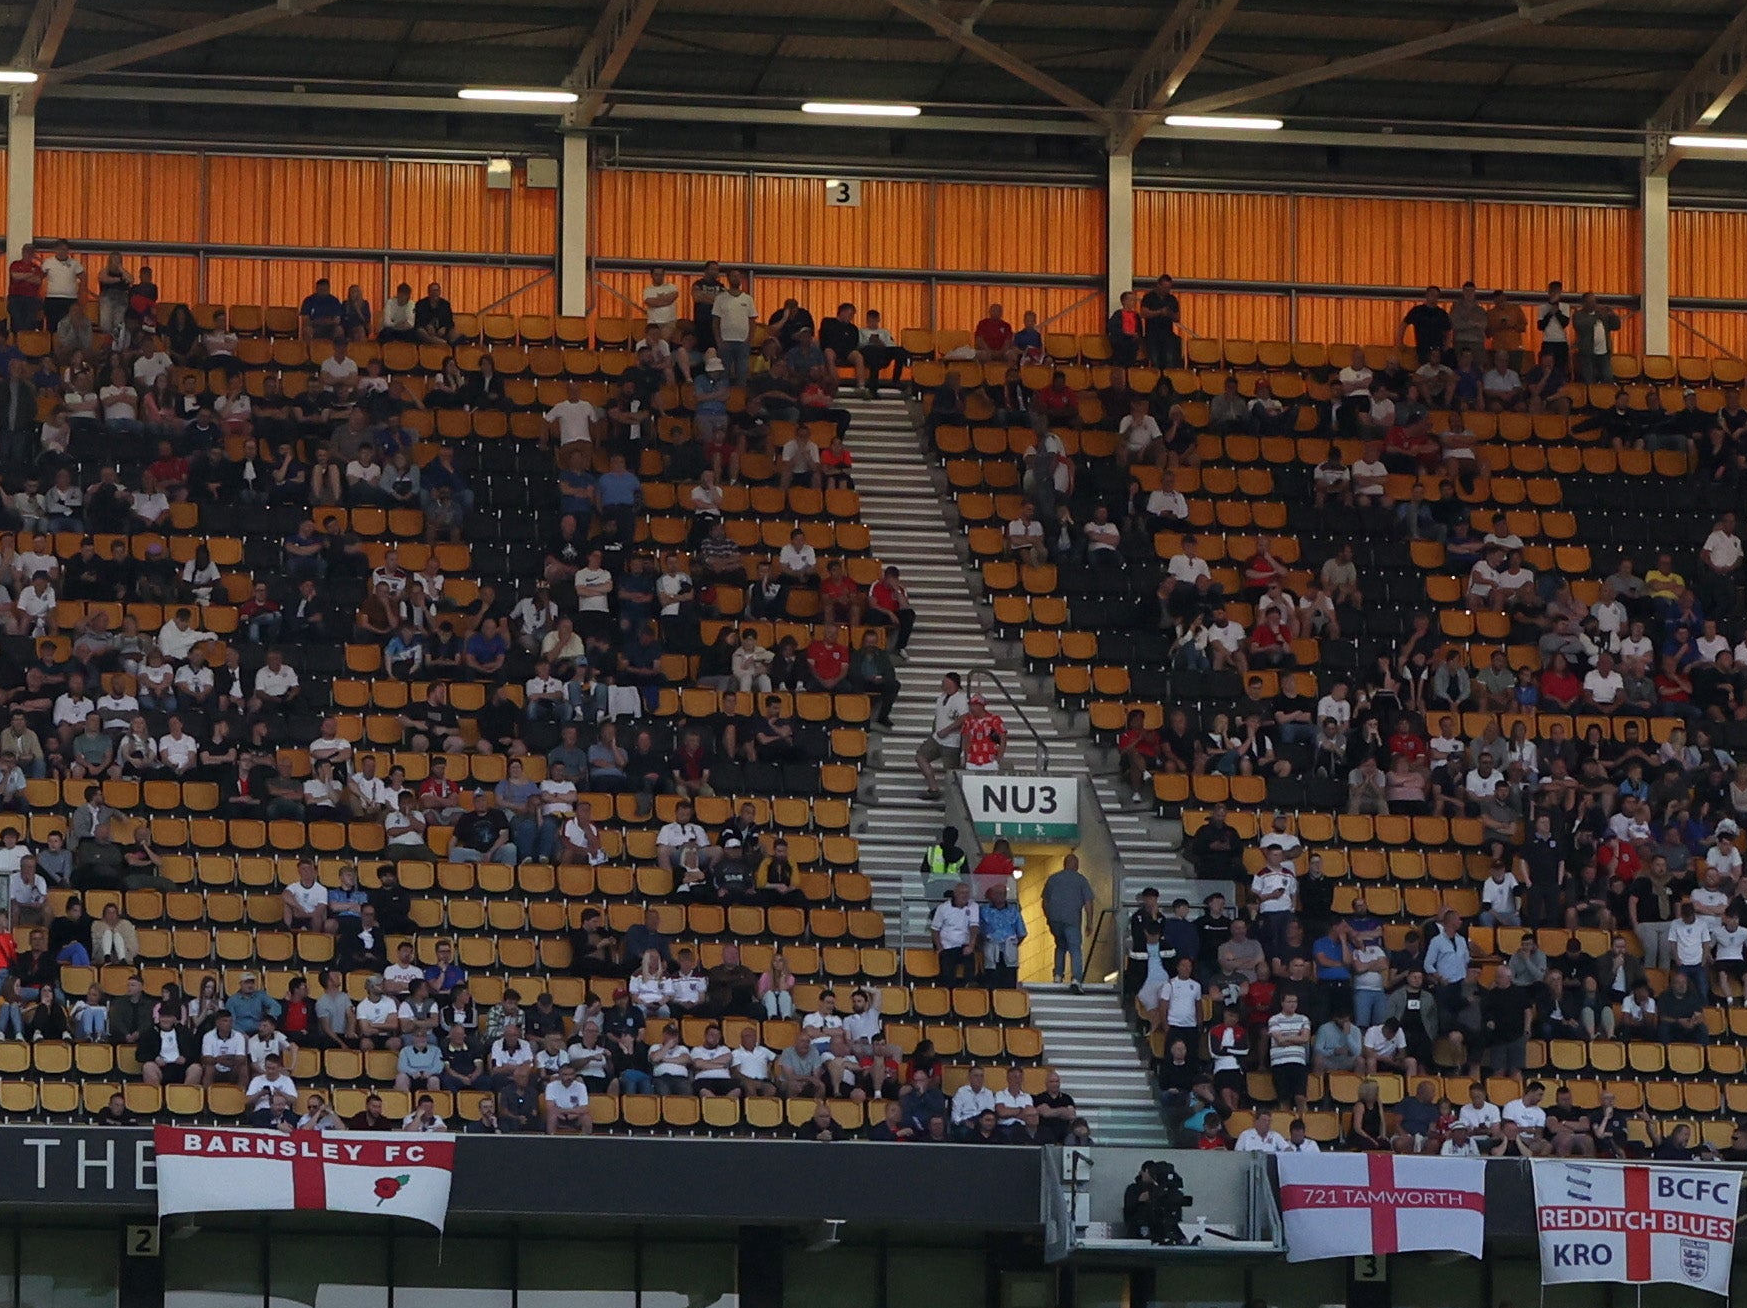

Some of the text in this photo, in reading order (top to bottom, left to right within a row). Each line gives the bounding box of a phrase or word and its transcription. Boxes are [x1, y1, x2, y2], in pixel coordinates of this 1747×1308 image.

[836, 182, 851, 203] 3
[982, 784, 1058, 814] NU3
[184, 1133, 426, 1165] BARNSLEY FC
[23, 1138, 158, 1191] THE
[1303, 1189, 1464, 1207] 721 TAMWORTH
[1657, 1176, 1731, 1206] BCFC
[1542, 1209, 1732, 1240] REDDITCH BLUES
[135, 1229, 152, 1253] 2
[1362, 1254, 1378, 1279] 3
[1553, 1243, 1614, 1268] KRO
